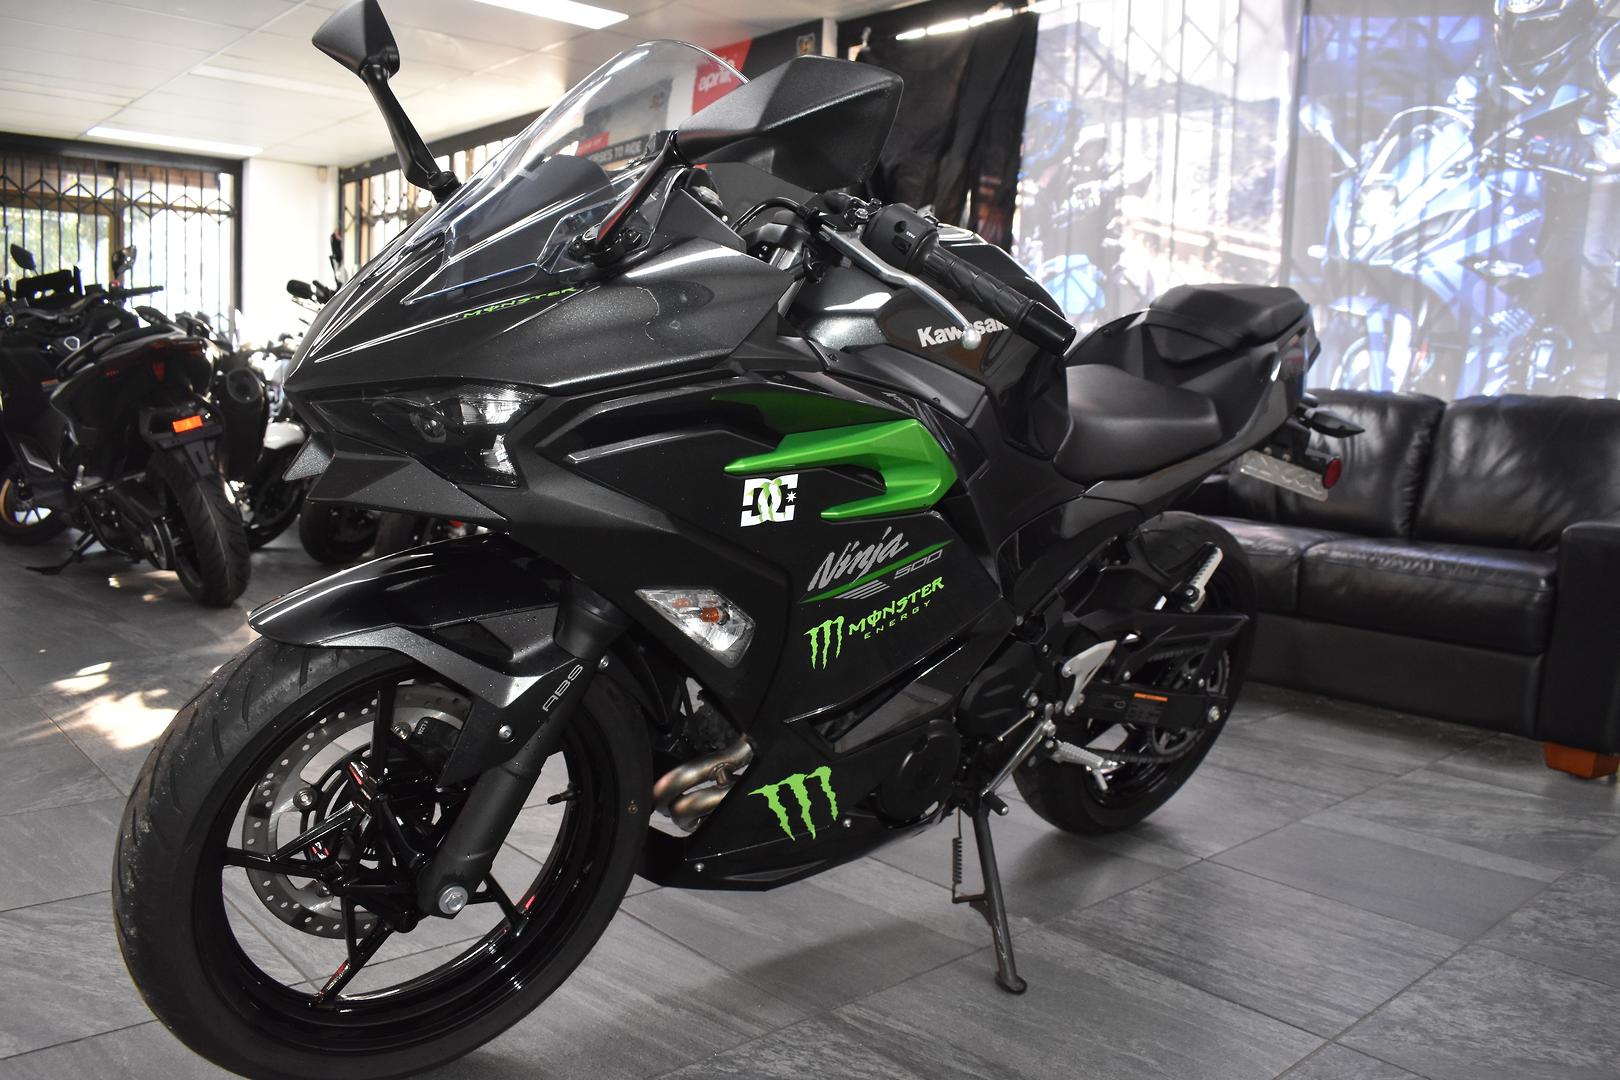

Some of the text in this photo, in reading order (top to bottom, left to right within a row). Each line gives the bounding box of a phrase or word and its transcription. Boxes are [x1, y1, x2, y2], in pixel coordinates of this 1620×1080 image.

[463, 287, 577, 319] MONSTER
[741, 473, 799, 527] DC
[807, 526, 909, 592] Ninja
[894, 549, 943, 580] 500
[848, 576, 945, 636] MONSTER
[863, 600, 931, 640] ENERGY
[542, 664, 583, 712] ABS
